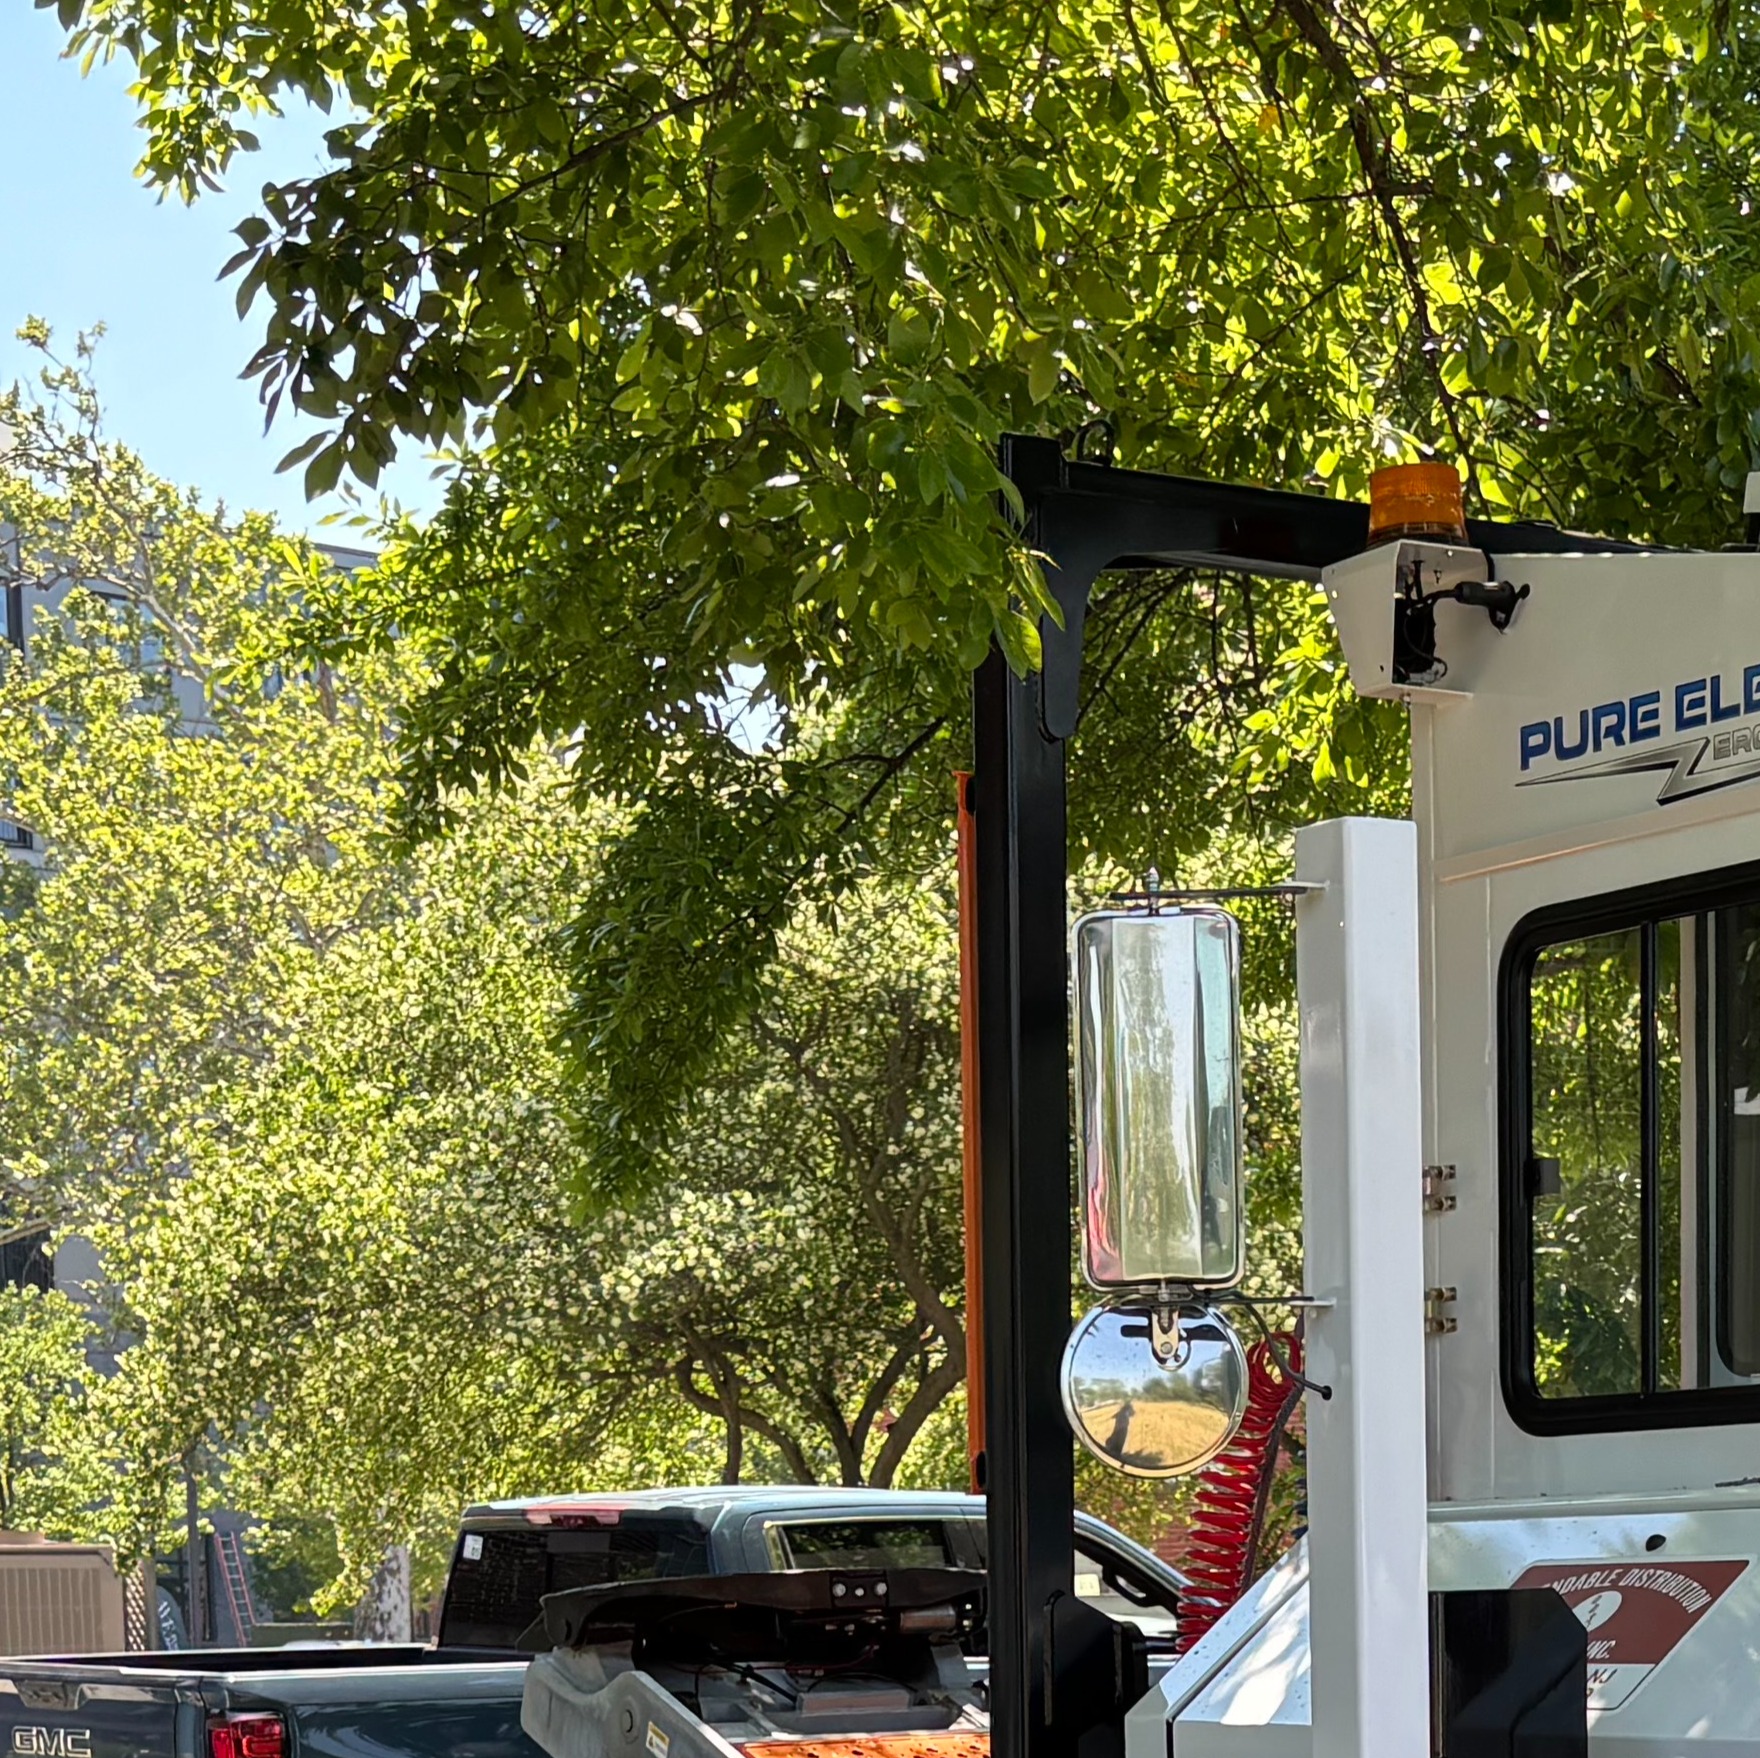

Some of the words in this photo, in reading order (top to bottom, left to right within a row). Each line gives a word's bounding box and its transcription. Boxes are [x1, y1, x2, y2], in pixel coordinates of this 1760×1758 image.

[1520, 690, 1661, 771] PURE
[1544, 1569, 1624, 1595] NDABLE
[1618, 1568, 1713, 1614] DISTRIBUTION
[12, 1726, 92, 1758] GMC
